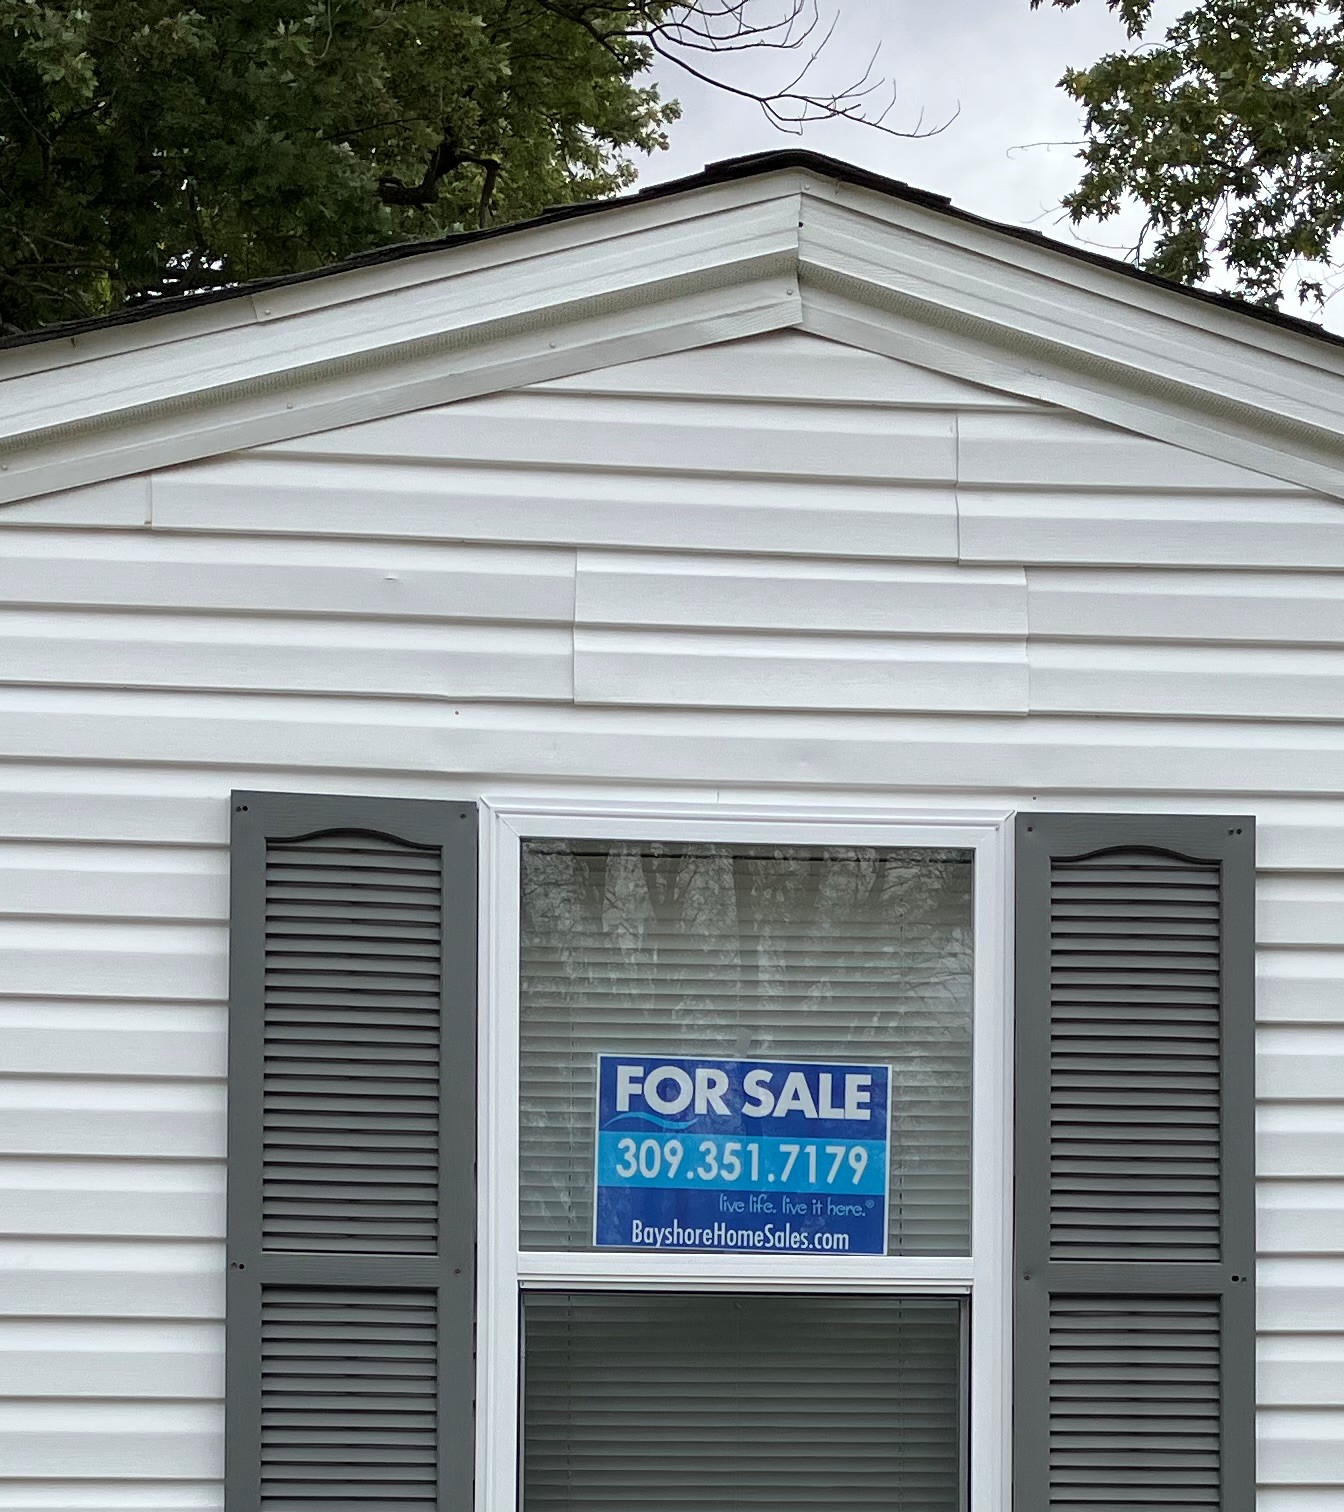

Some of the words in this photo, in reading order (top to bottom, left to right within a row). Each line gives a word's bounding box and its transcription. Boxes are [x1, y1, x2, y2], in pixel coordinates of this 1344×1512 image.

[616, 1065, 731, 1116] FOR
[741, 1069, 873, 1121] SALE
[615, 1137, 869, 1185] 309.351.7179
[719, 1193, 745, 1214] live
[749, 1194, 776, 1214] life.
[782, 1196, 808, 1216] live
[812, 1199, 824, 1216] it
[631, 1219, 850, 1250] BayshoreHomeSales.com
